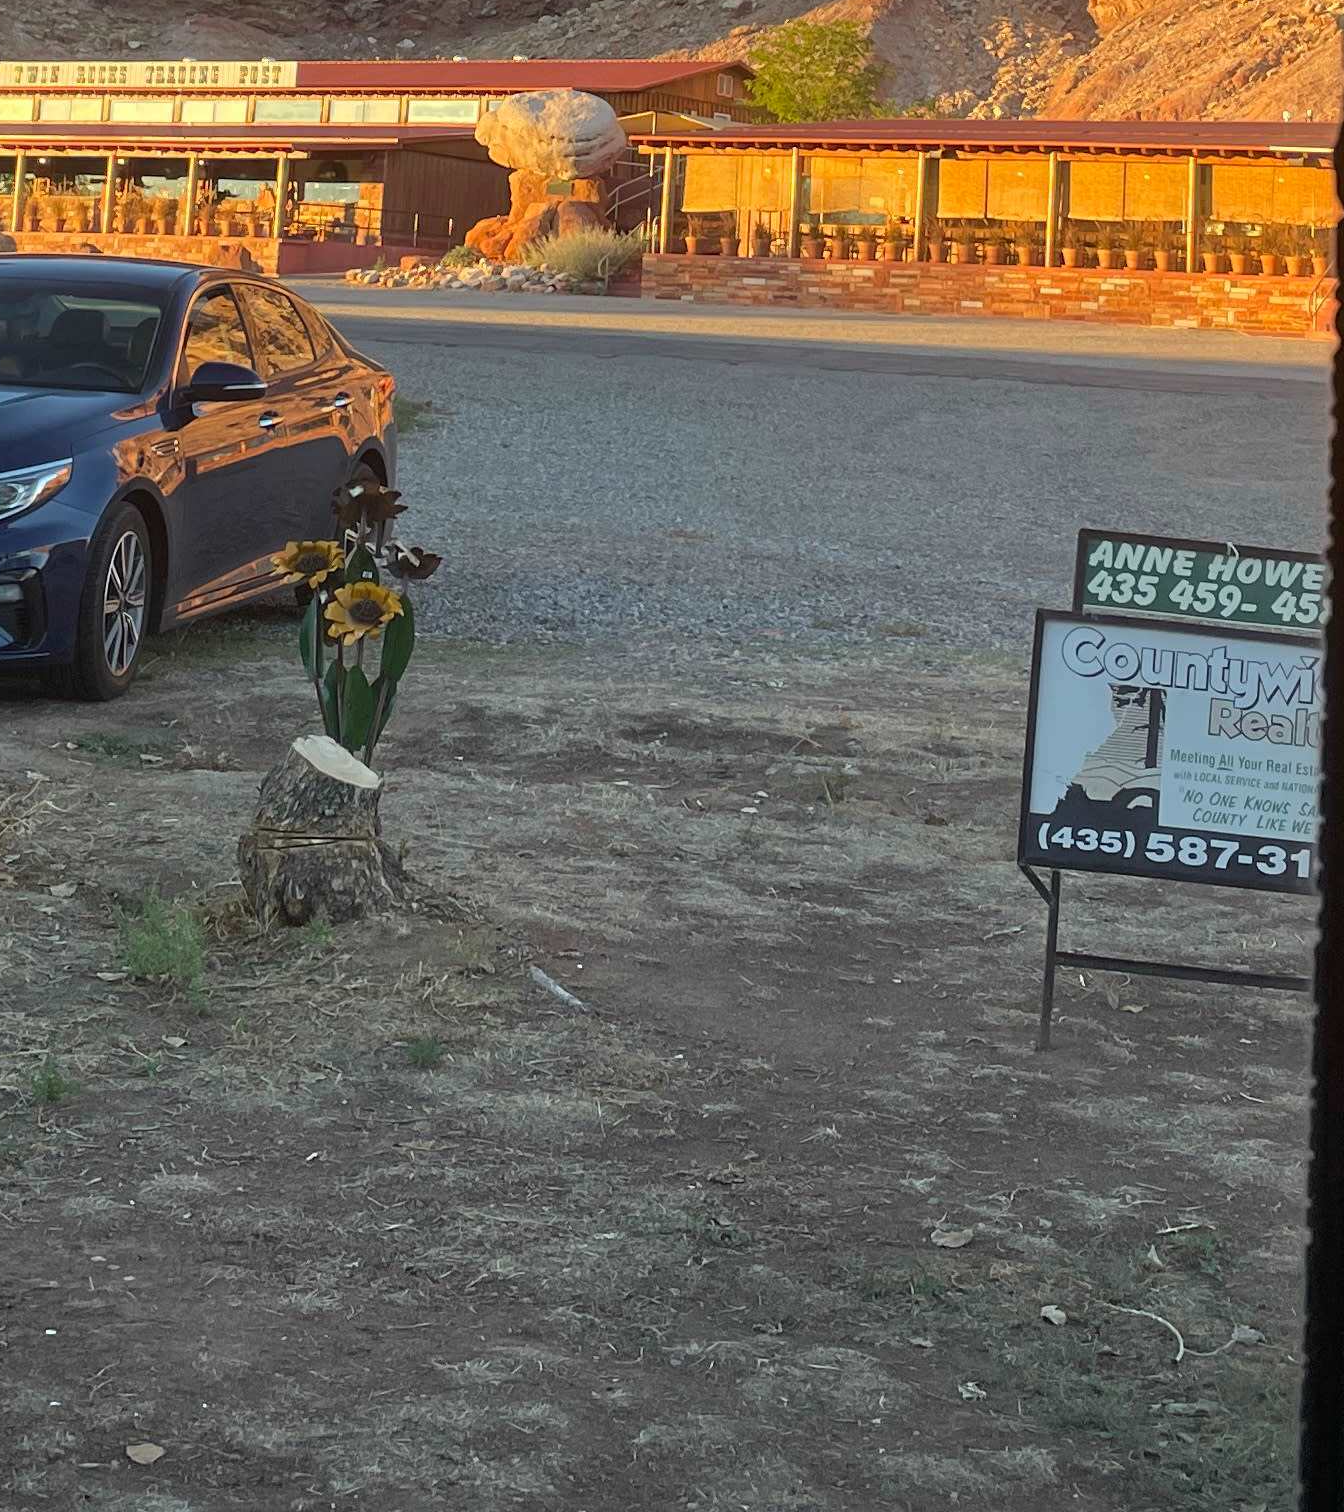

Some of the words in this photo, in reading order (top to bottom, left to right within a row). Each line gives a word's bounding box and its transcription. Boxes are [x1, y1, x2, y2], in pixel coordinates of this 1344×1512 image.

[145, 65, 219, 85] TRADING
[239, 65, 283, 85] POST
[1088, 540, 1197, 578] ANNE
[1087, 570, 1159, 607] 435
[1170, 749, 1216, 767] Meeting
[1218, 754, 1234, 771] All
[1239, 756, 1263, 770] Your
[1266, 759, 1292, 774] Real
[1194, 772, 1222, 785] LOCAL
[1225, 776, 1261, 789] SERVICE
[1263, 781, 1280, 790] and
[1209, 792, 1238, 808] ONE
[1244, 795, 1291, 814] KNOWS
[1192, 808, 1248, 826] COUNTY
[1256, 815, 1287, 832] LIKE
[1292, 819, 1313, 834] WE
[1037, 822, 1136, 859] (435)
